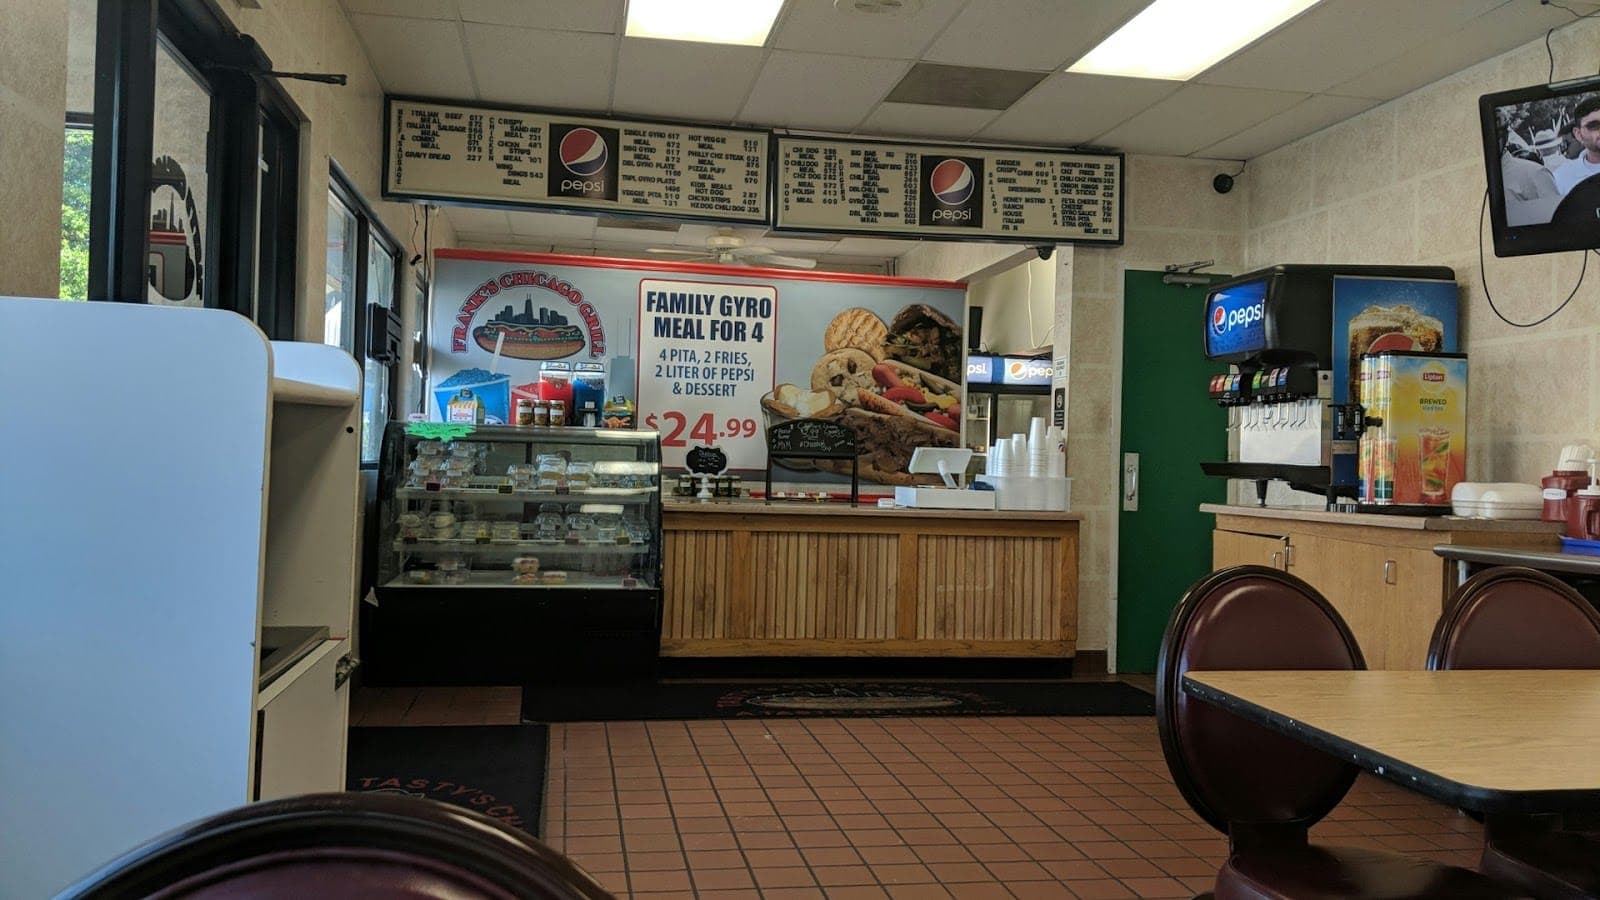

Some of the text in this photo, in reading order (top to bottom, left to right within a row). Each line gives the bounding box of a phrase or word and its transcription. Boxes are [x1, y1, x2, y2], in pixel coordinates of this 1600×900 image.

[648, 131, 665, 139] GYRO
[561, 179, 604, 193] pepsi
[933, 208, 971, 221] pepsi
[452, 279, 499, 352] FRANK'S
[499, 271, 582, 304] CHICAGO
[647, 291, 772, 319] FAMILY GYRO
[1228, 298, 1265, 331] pepsi
[654, 317, 764, 343] MEAL FOR 4
[659, 348, 752, 366] 4 PITA, 2 FRIES,
[655, 365, 754, 382] 2 LITER OF PEPSI
[1424, 373, 1444, 381] Lipton
[672, 382, 737, 397] & DESSERT
